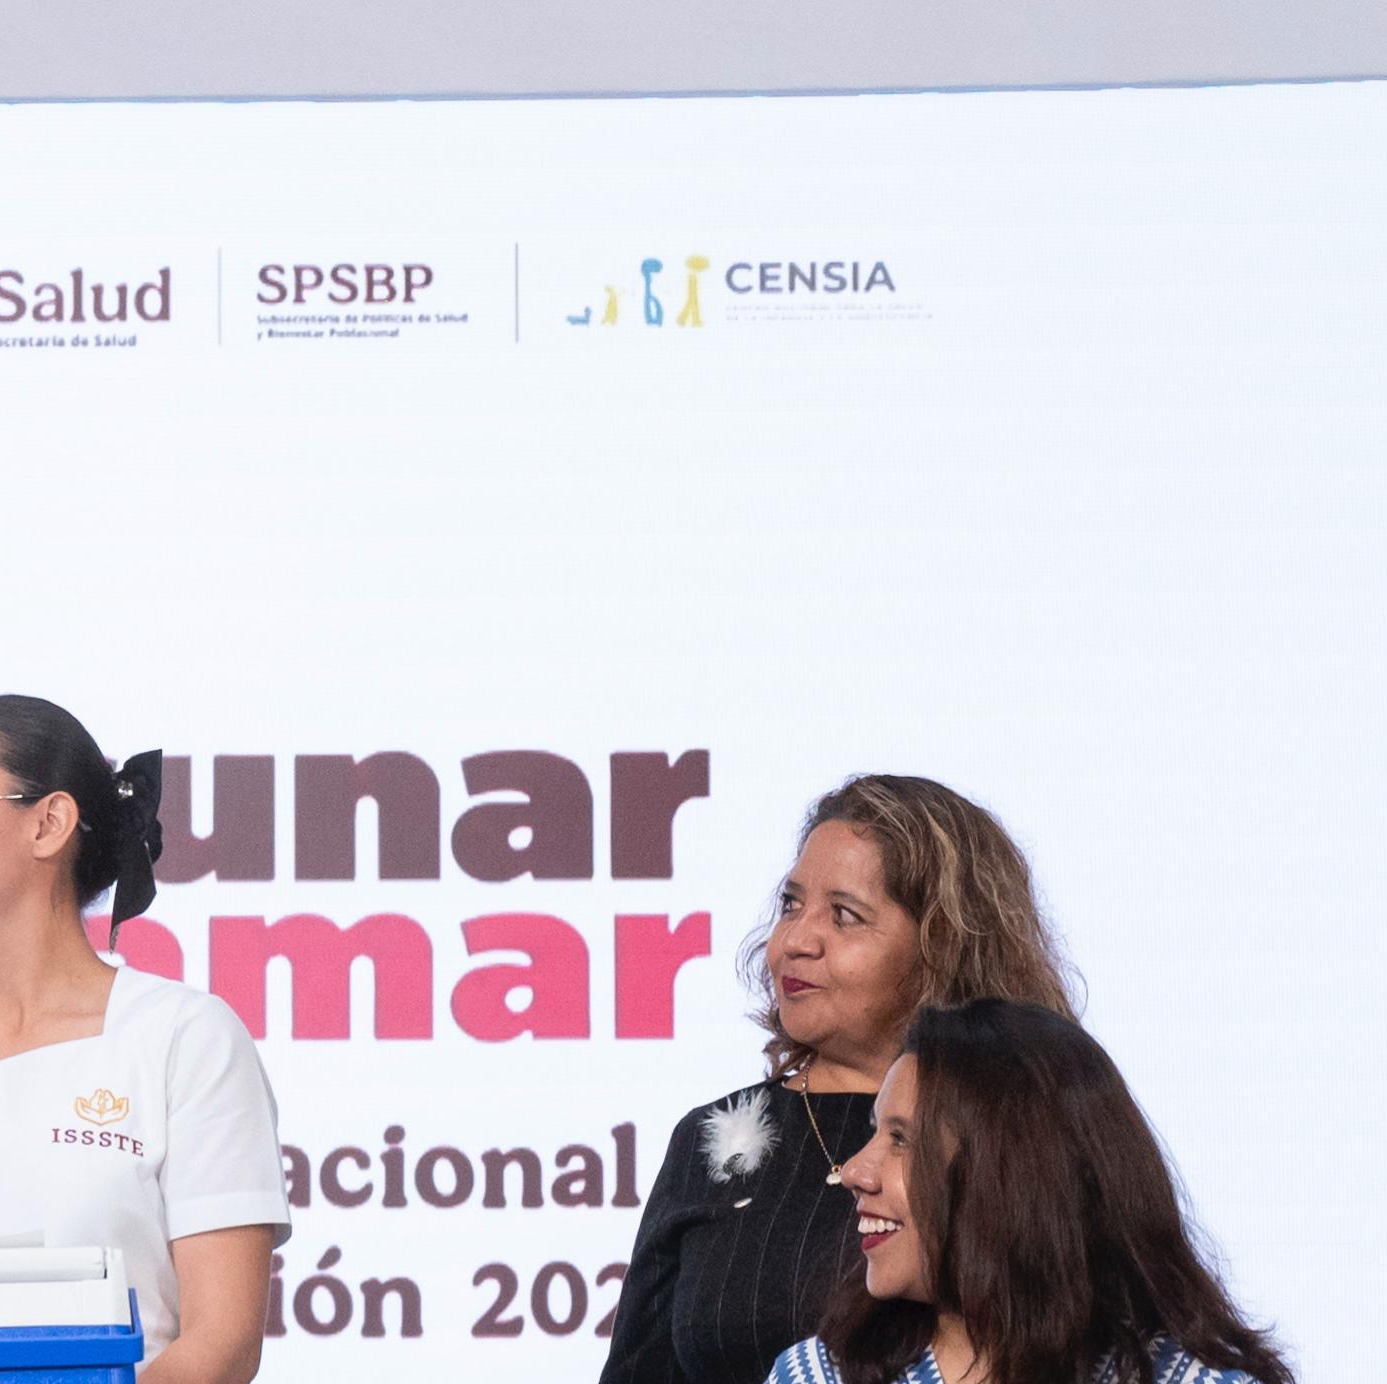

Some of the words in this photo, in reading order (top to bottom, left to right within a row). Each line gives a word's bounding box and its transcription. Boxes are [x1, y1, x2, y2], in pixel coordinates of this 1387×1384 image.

[256, 263, 434, 304] SPSBP
[725, 261, 896, 293] CENSIA
[95, 335, 137, 347] Salud
[107, 748, 711, 884] unar
[52, 1128, 144, 1157] ISSSTE
